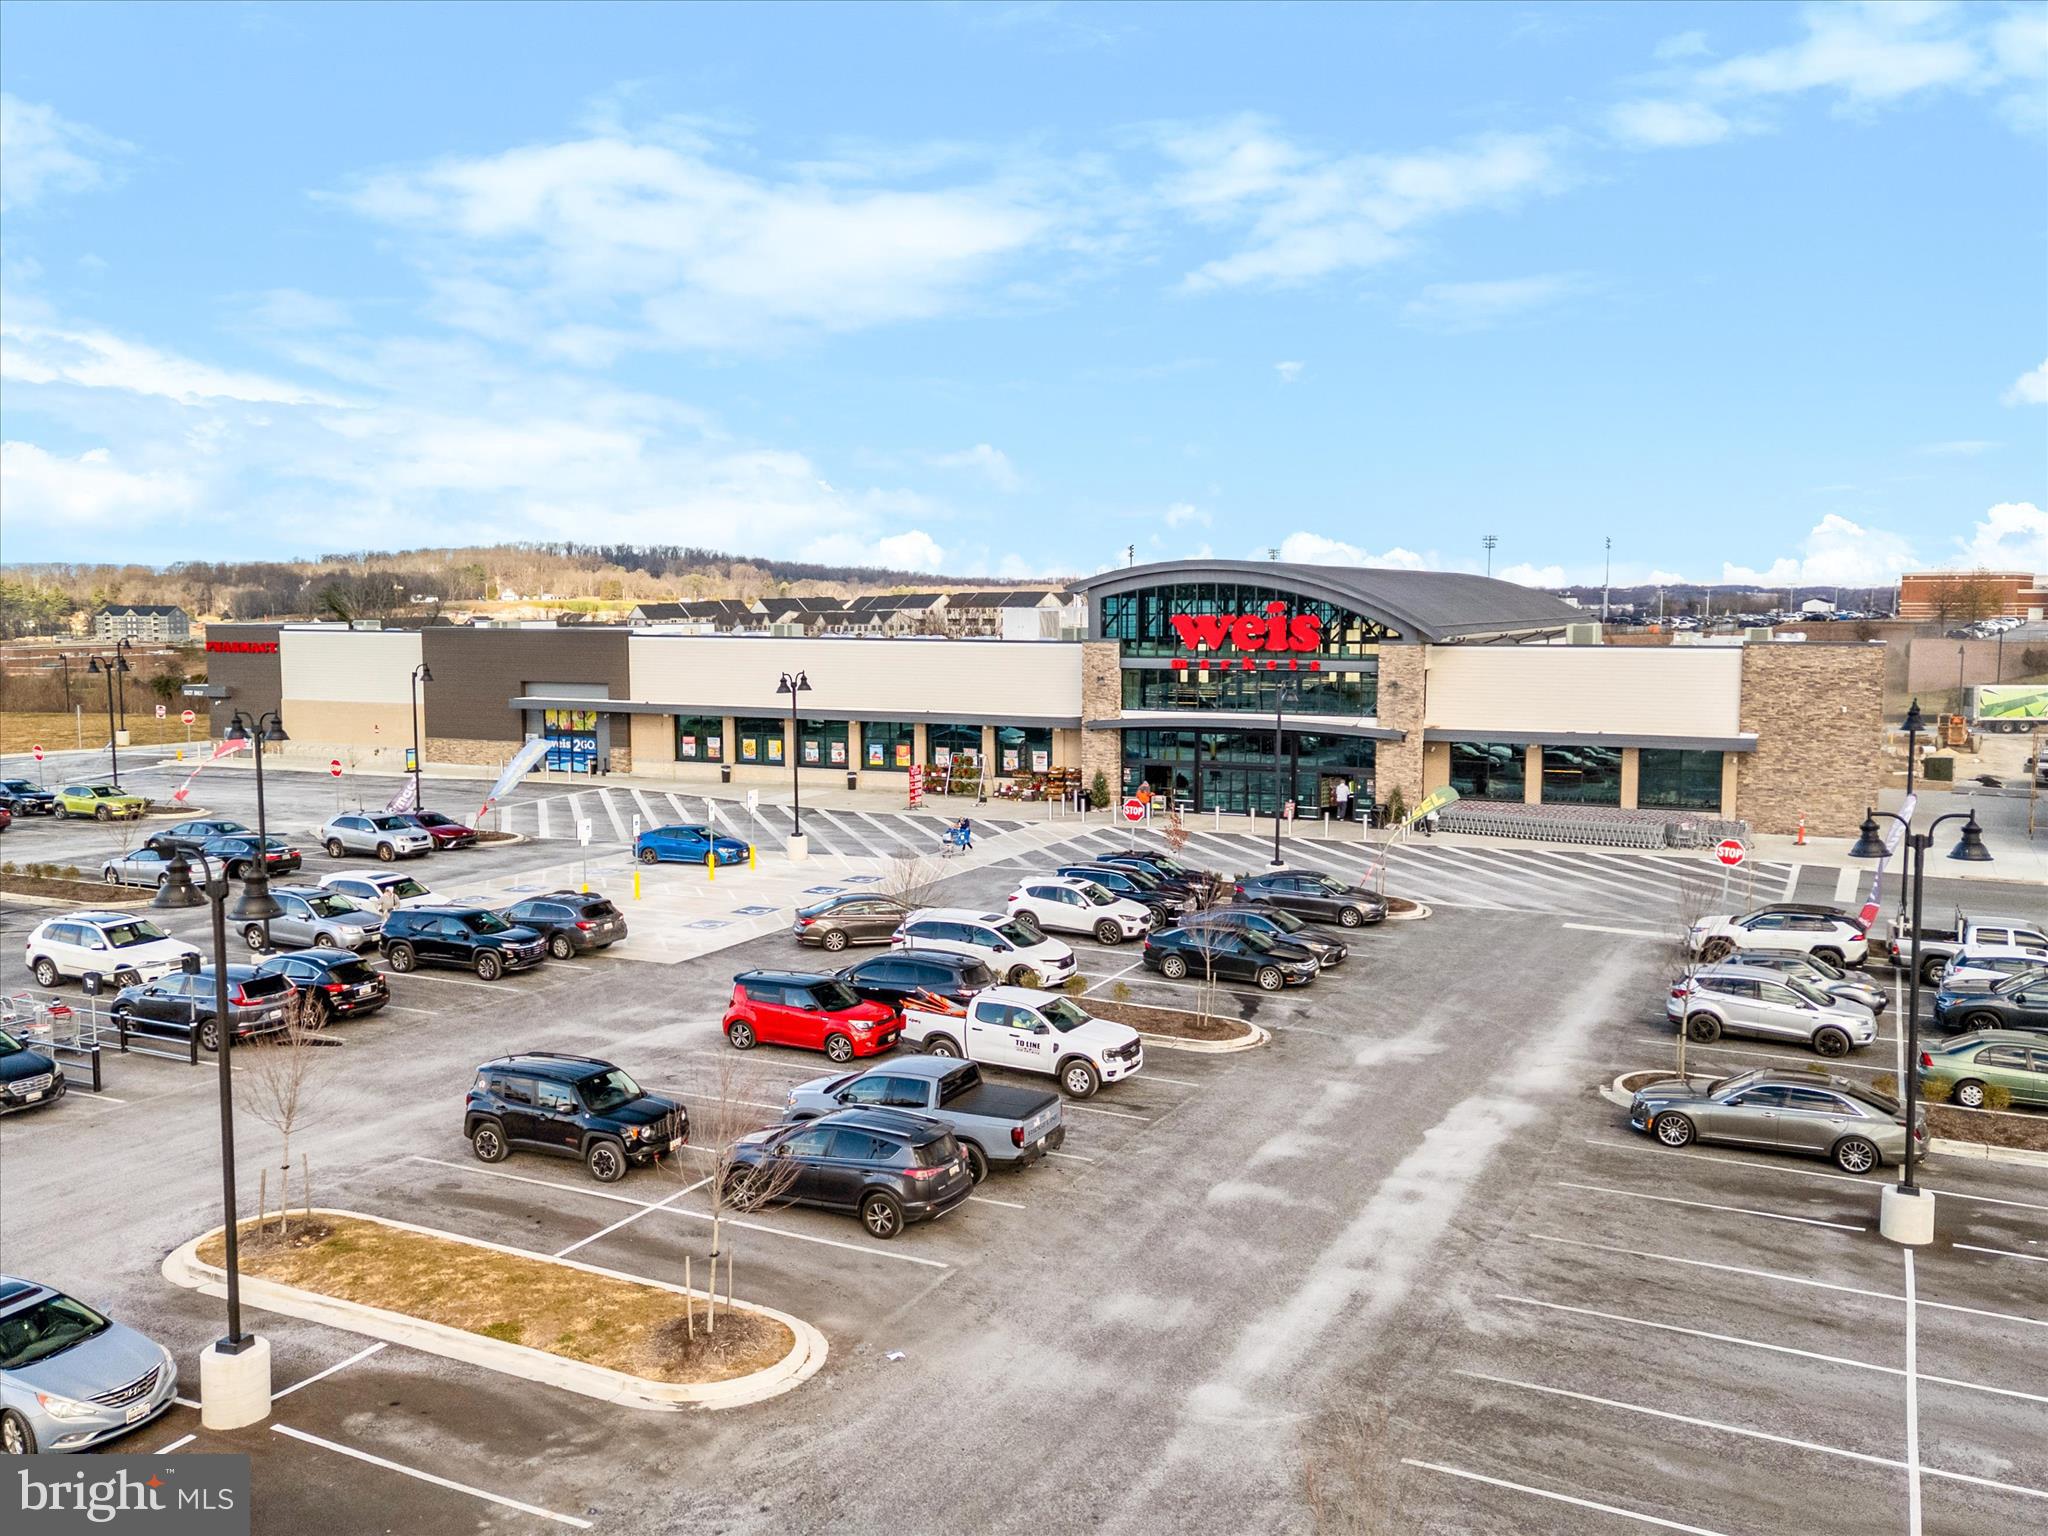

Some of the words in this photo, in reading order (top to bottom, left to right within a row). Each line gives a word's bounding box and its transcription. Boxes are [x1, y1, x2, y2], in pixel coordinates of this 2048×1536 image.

[1170, 600, 1321, 652] weis
[206, 641, 278, 654] PHARMACY
[1171, 657, 1321, 671] markets
[1125, 806, 1143, 815] STOP
[1718, 847, 1743, 858] STOP
[1026, 1041, 1040, 1049] LINE
